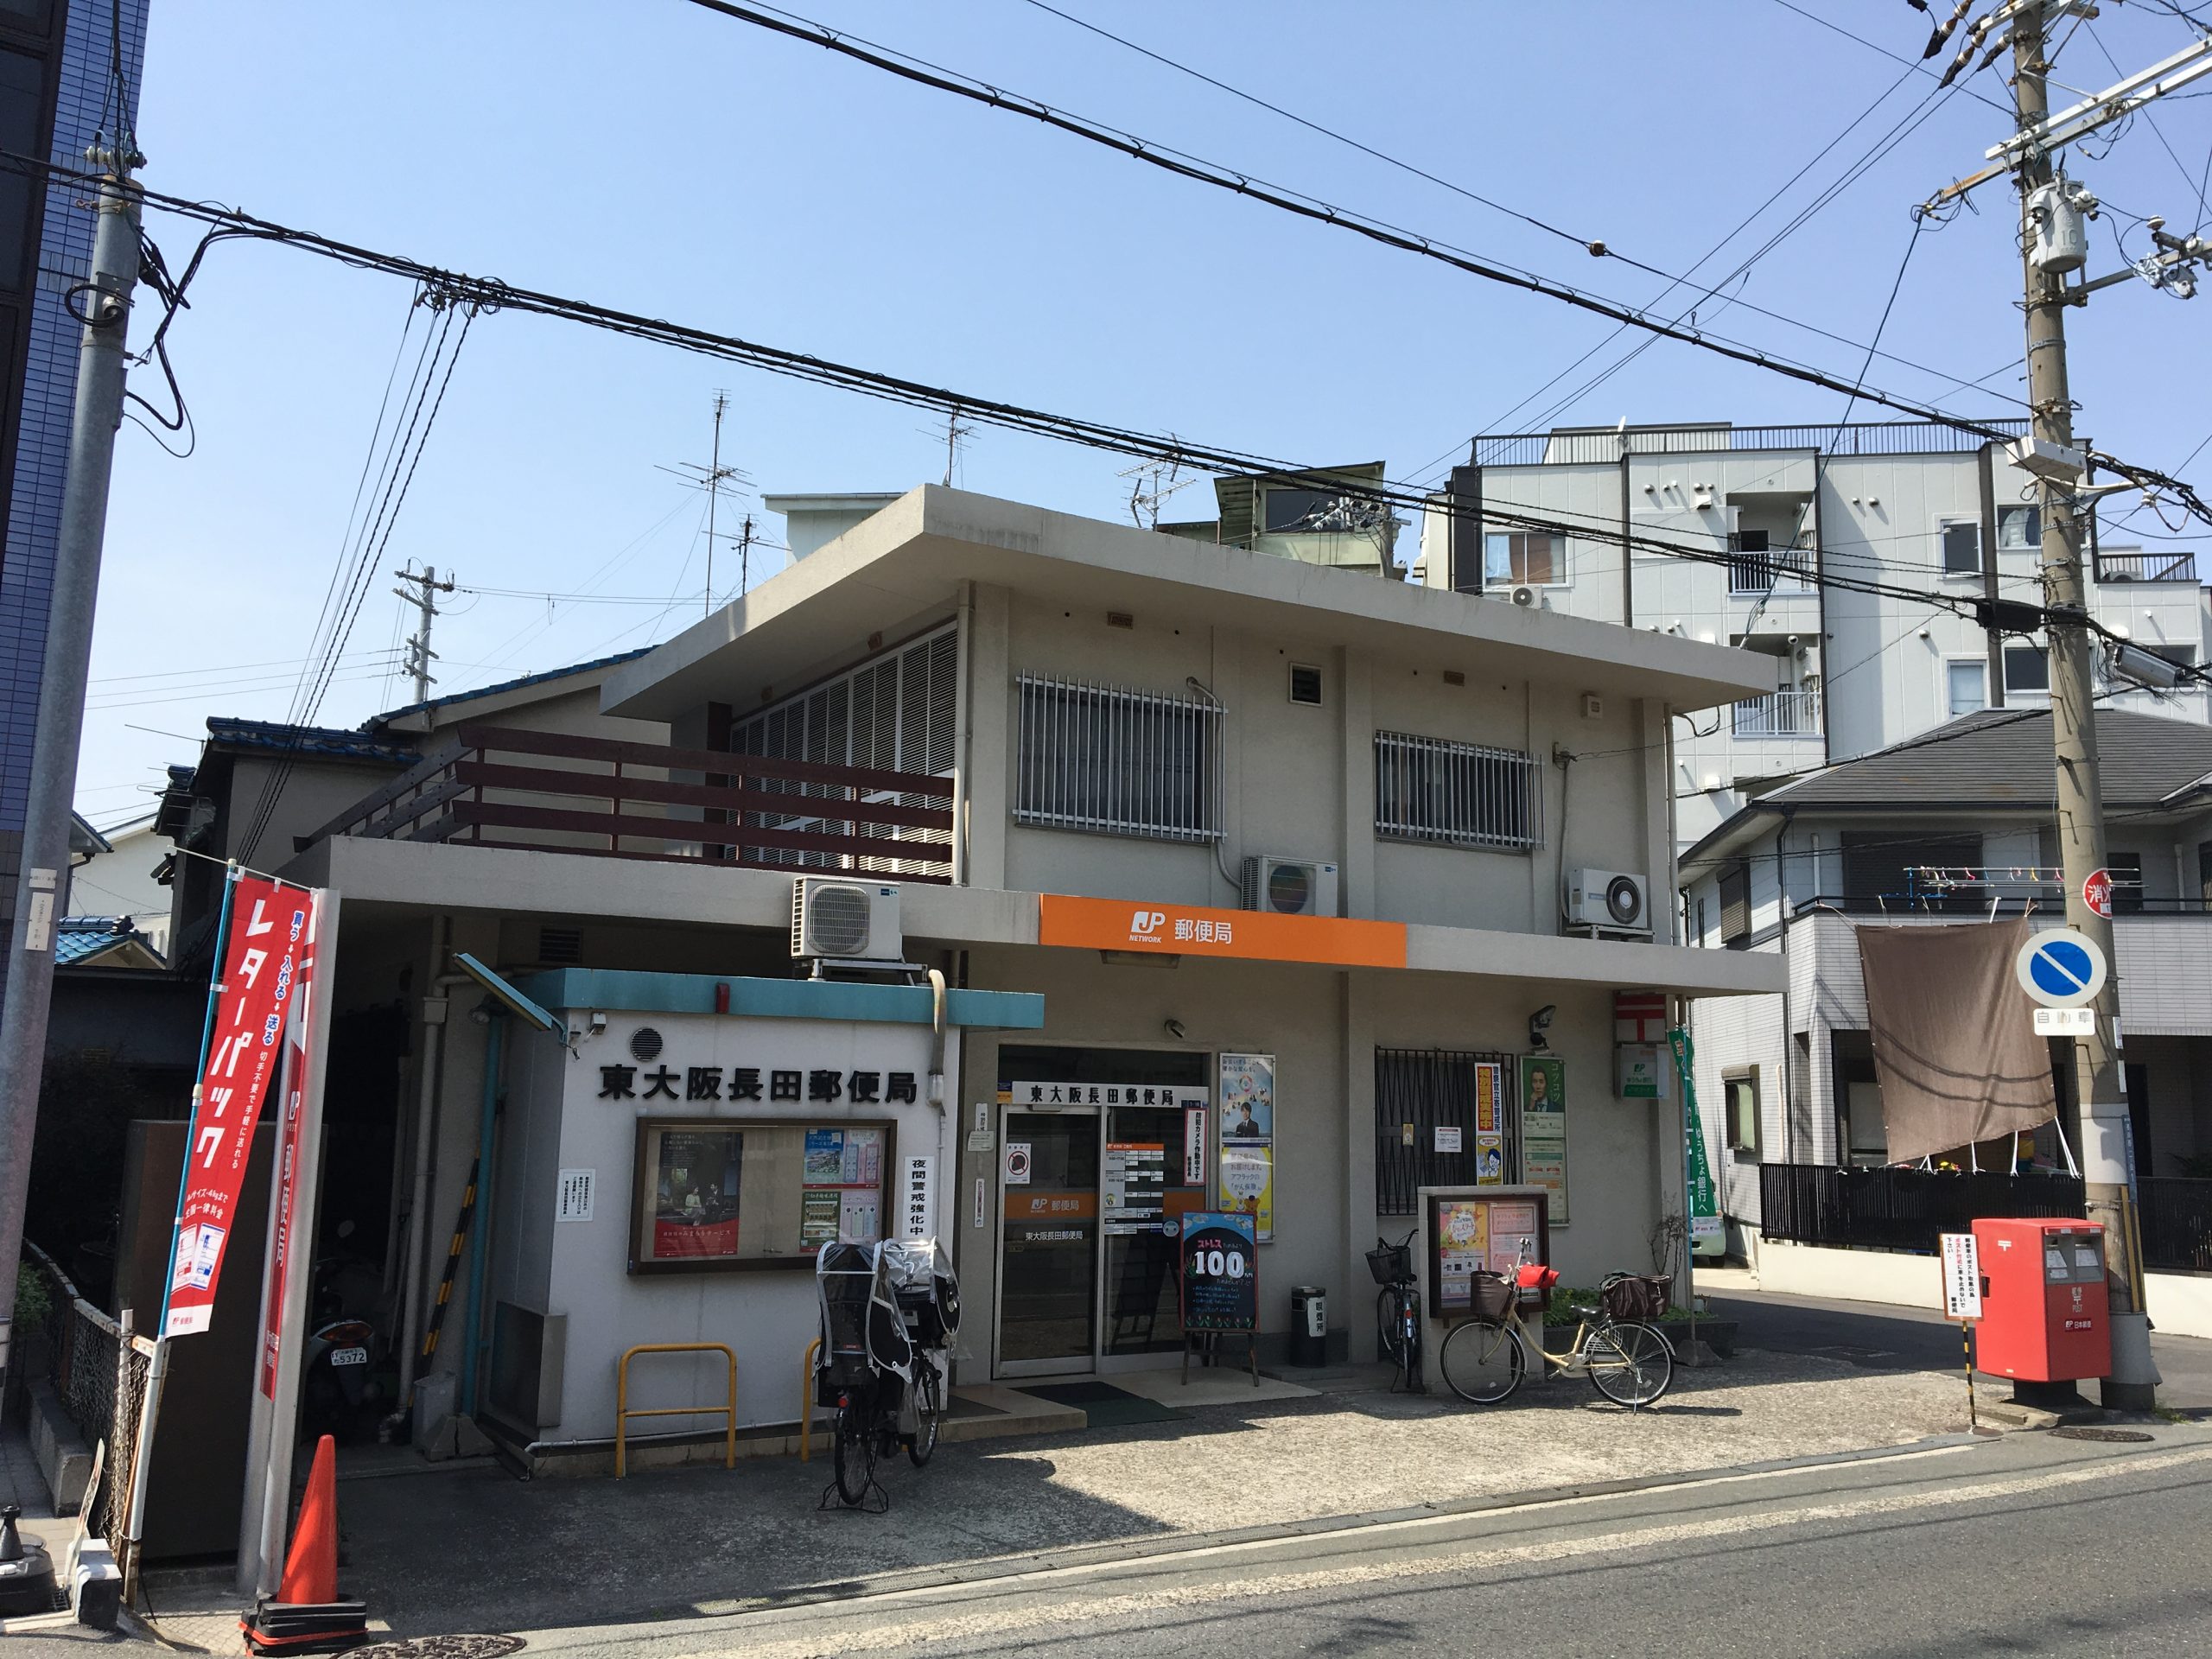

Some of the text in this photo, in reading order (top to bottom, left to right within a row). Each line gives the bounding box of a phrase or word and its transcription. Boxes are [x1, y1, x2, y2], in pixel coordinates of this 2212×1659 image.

[1130, 911, 1166, 934] JP
[1173, 918, 1233, 945] 郵便局
[1128, 934, 1162, 944] NETWORK
[262, 910, 304, 1046] 買う 入れる 送る
[194, 899, 274, 1169] レターパック
[599, 1063, 918, 1104] 東大阪長田郵便局
[1030, 1085, 1174, 1106] 東大阪長田郵便局
[909, 1159, 927, 1236] 夜間警戒強化中
[1051, 1199, 1079, 1211] 郵便局
[1025, 1230, 1084, 1241] 東大阪長田郵便局
[1197, 1238, 1222, 1249] ストレス
[1194, 1250, 1244, 1279] 100
[1315, 1301, 1324, 1332] 喫煙所
[340, 1352, 365, 1363] 5372
